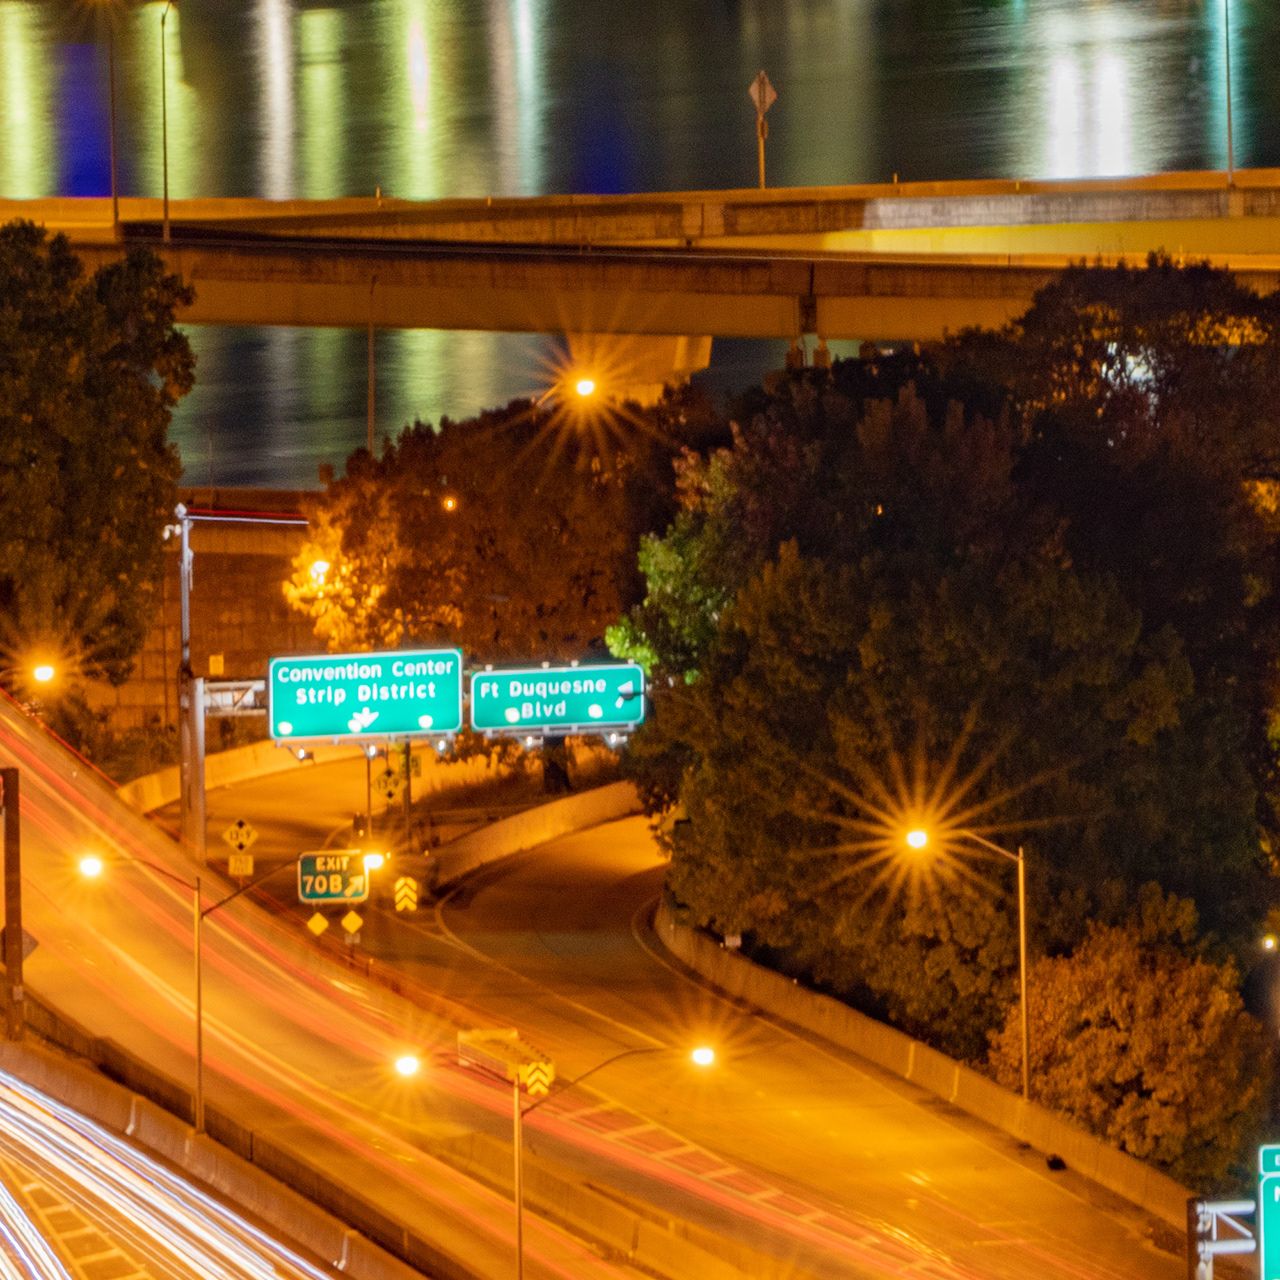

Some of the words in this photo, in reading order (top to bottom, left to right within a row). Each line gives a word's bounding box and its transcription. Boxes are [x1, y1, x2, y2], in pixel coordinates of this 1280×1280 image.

[278, 663, 381, 682] Convention
[392, 660, 453, 677] Center
[297, 686, 346, 706] Strip
[358, 682, 435, 700] District
[481, 682, 498, 698] Ft
[510, 679, 606, 698] Duquesne
[522, 701, 565, 718] Blvd
[316, 856, 349, 871] EXIT
